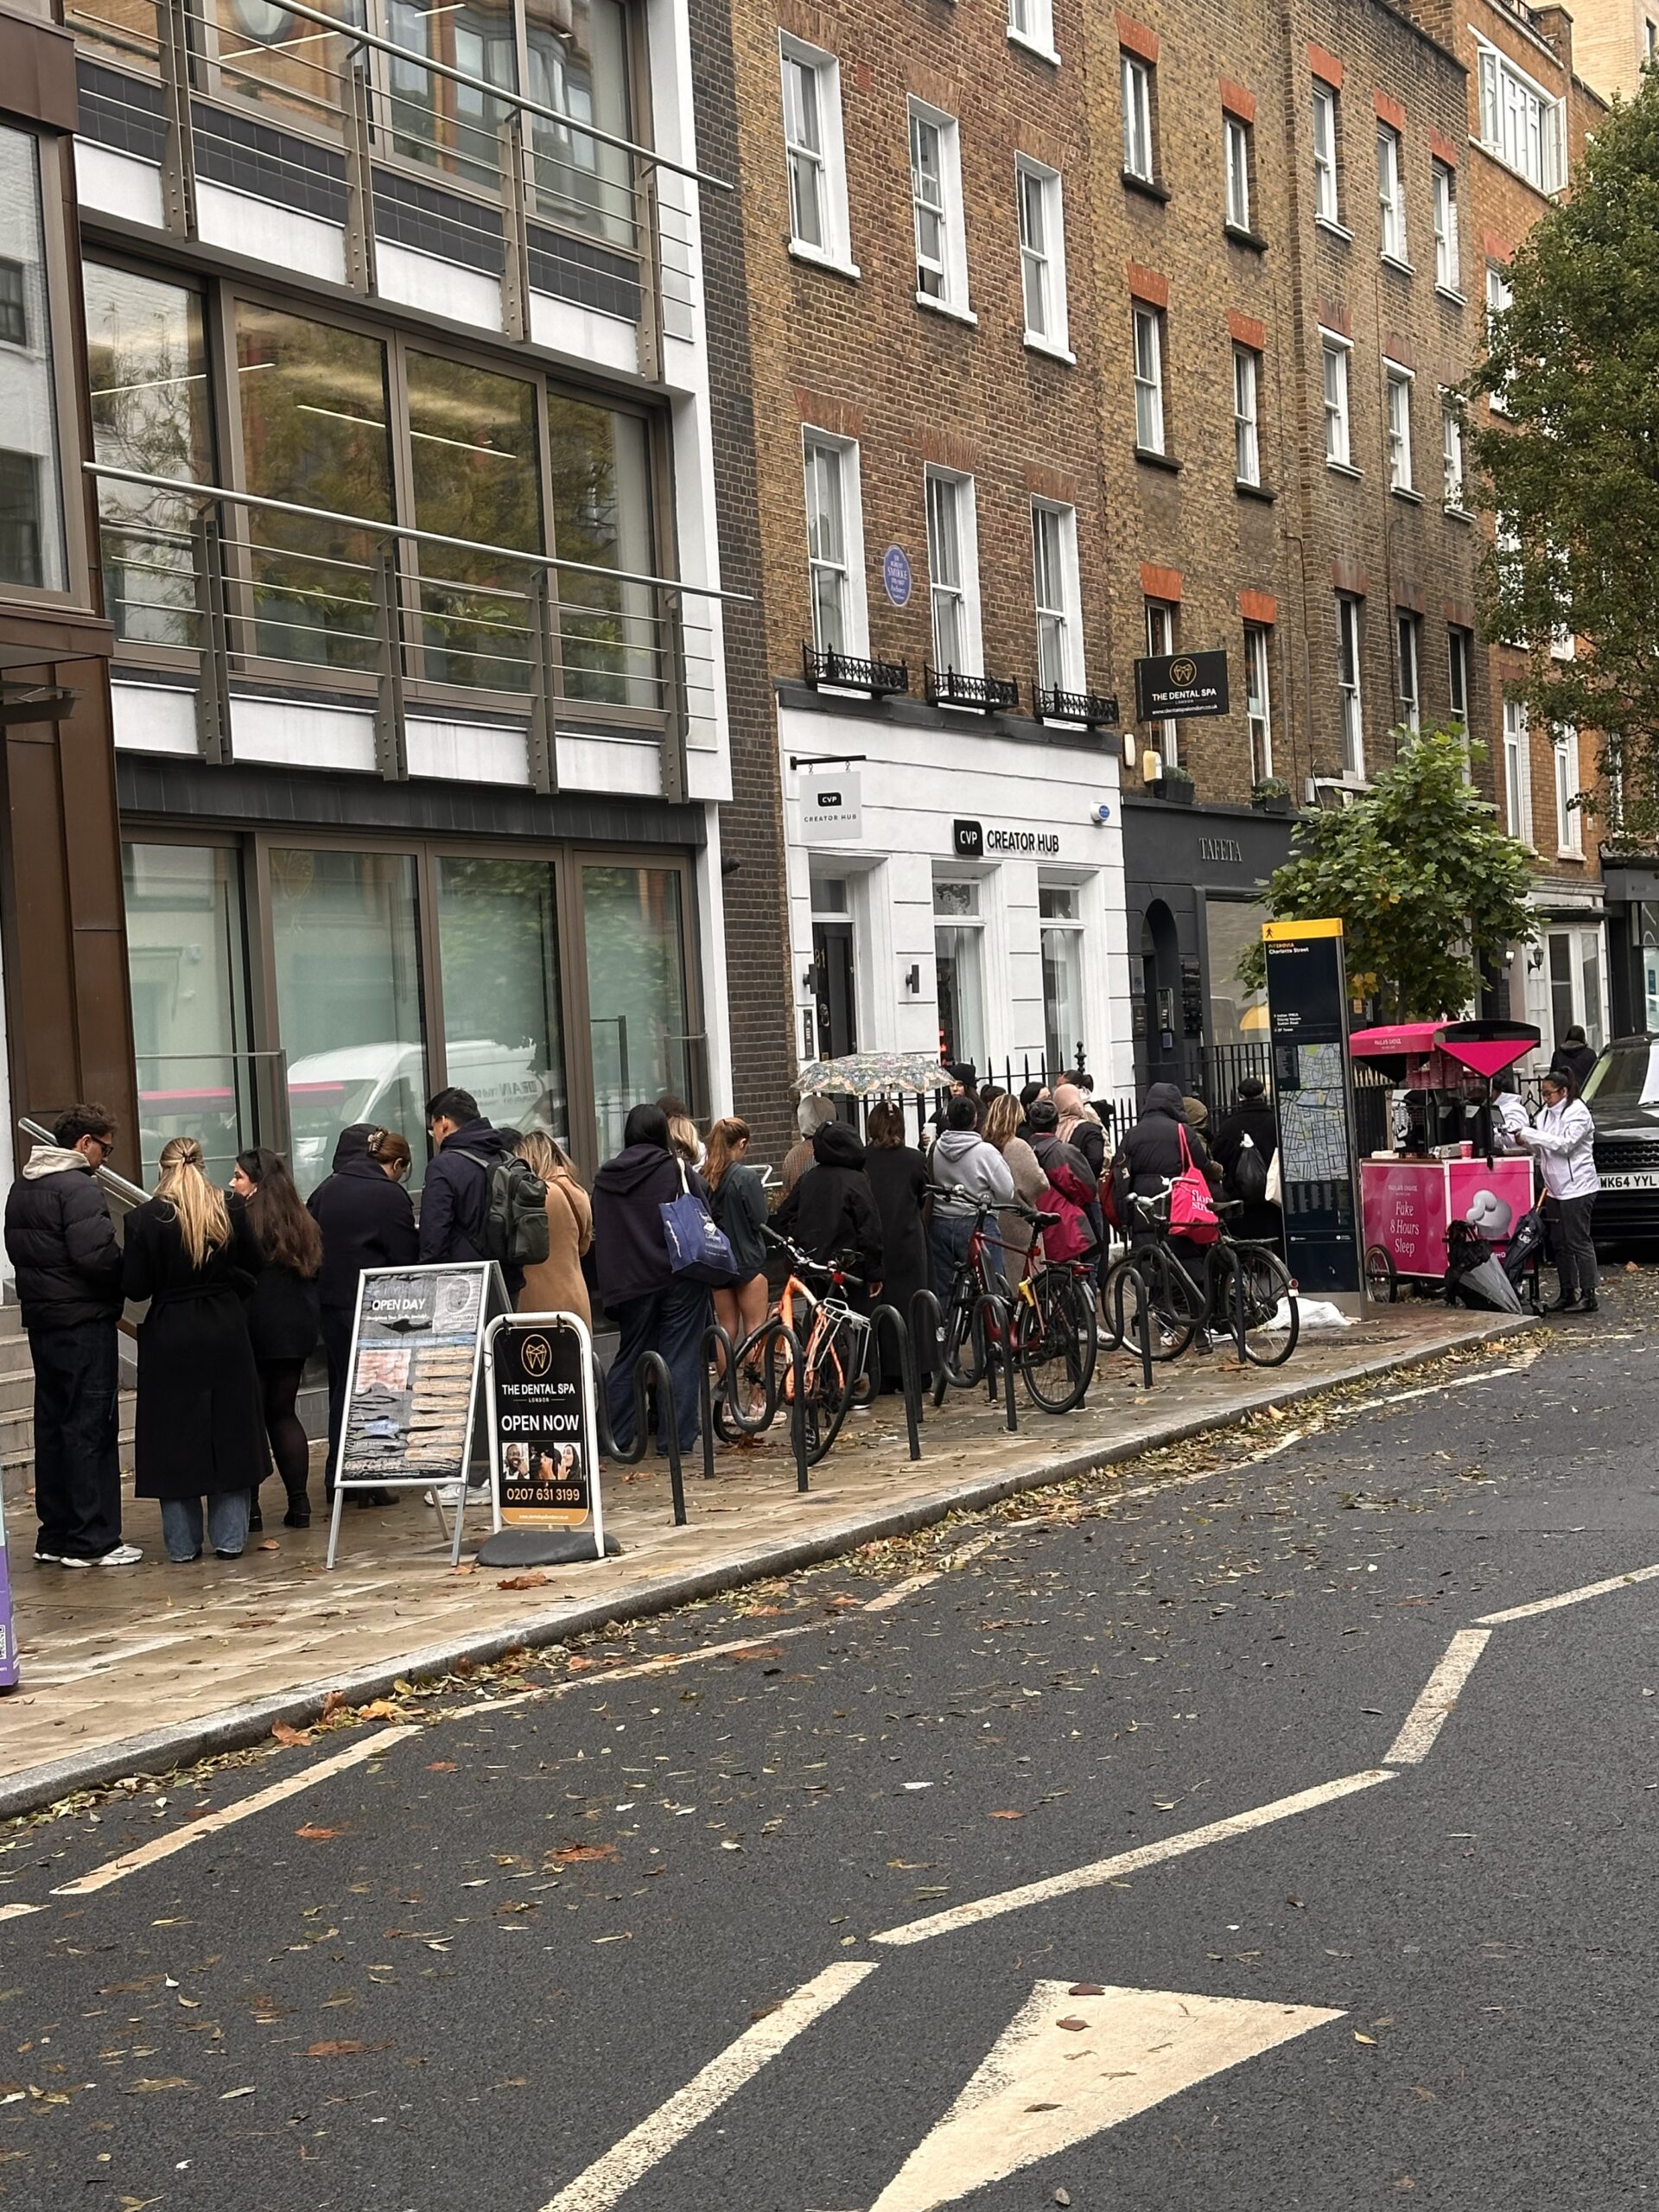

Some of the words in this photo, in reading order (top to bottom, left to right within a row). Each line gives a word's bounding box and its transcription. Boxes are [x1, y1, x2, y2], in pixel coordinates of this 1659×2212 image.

[887, 567, 908, 580] SMIRKE
[1151, 692, 1168, 702] THE
[1169, 690, 1200, 700] DENTAL
[1201, 688, 1217, 697] SPA
[960, 830, 978, 845] CVP
[987, 830, 1036, 851] CREATOR
[1037, 833, 1060, 853] HUB
[1198, 837, 1243, 862] TAFETA
[1599, 1176, 1631, 1189] WK64
[1633, 1174, 1658, 1187] YYL
[1192, 1189, 1214, 1204] flor
[1395, 1201, 1414, 1217] Fake
[1389, 1218, 1395, 1234] 8
[1396, 1219, 1420, 1236] Hours
[1395, 1237, 1415, 1257] Sleep
[372, 1299, 401, 1311] OPEN
[402, 1299, 426, 1310] DAY
[502, 1384, 520, 1395] THE
[521, 1383, 556, 1395] DENTAL
[557, 1382, 575, 1395] SPA
[501, 1414, 540, 1431] OPEN
[543, 1414, 579, 1431] NOW
[506, 1488, 534, 1501] 0207
[536, 1488, 554, 1501] 631
[556, 1488, 580, 1501] 3199
